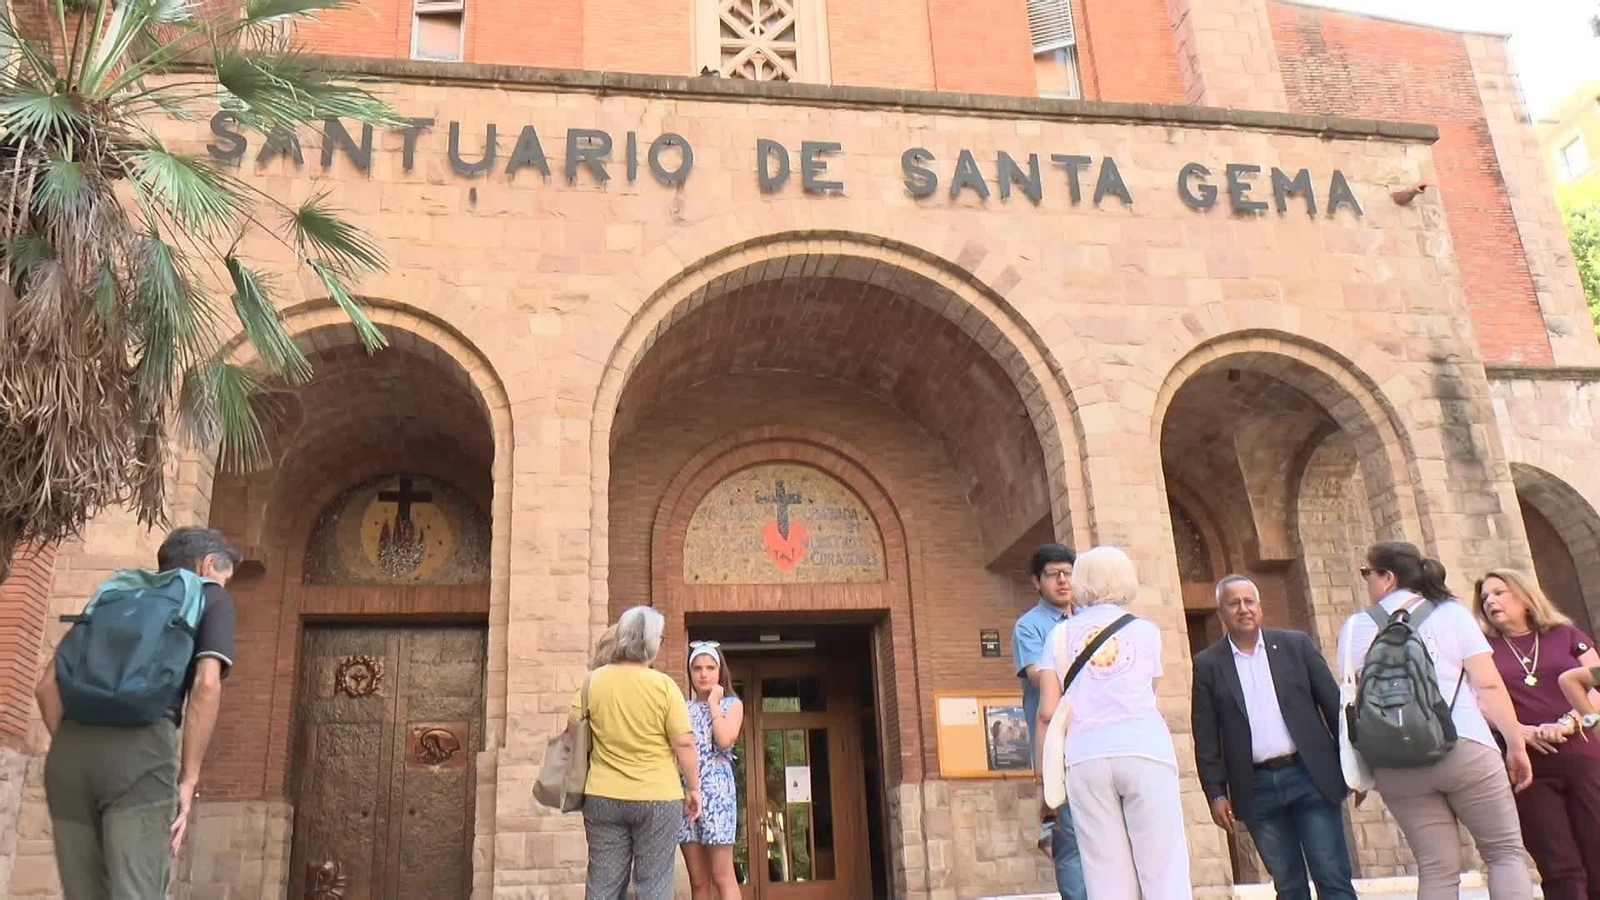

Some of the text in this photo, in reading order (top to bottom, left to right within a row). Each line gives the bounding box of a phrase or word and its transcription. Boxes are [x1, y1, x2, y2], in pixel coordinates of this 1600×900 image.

[206, 110, 1364, 216] SANTUARIO DE SANTA GEMA
